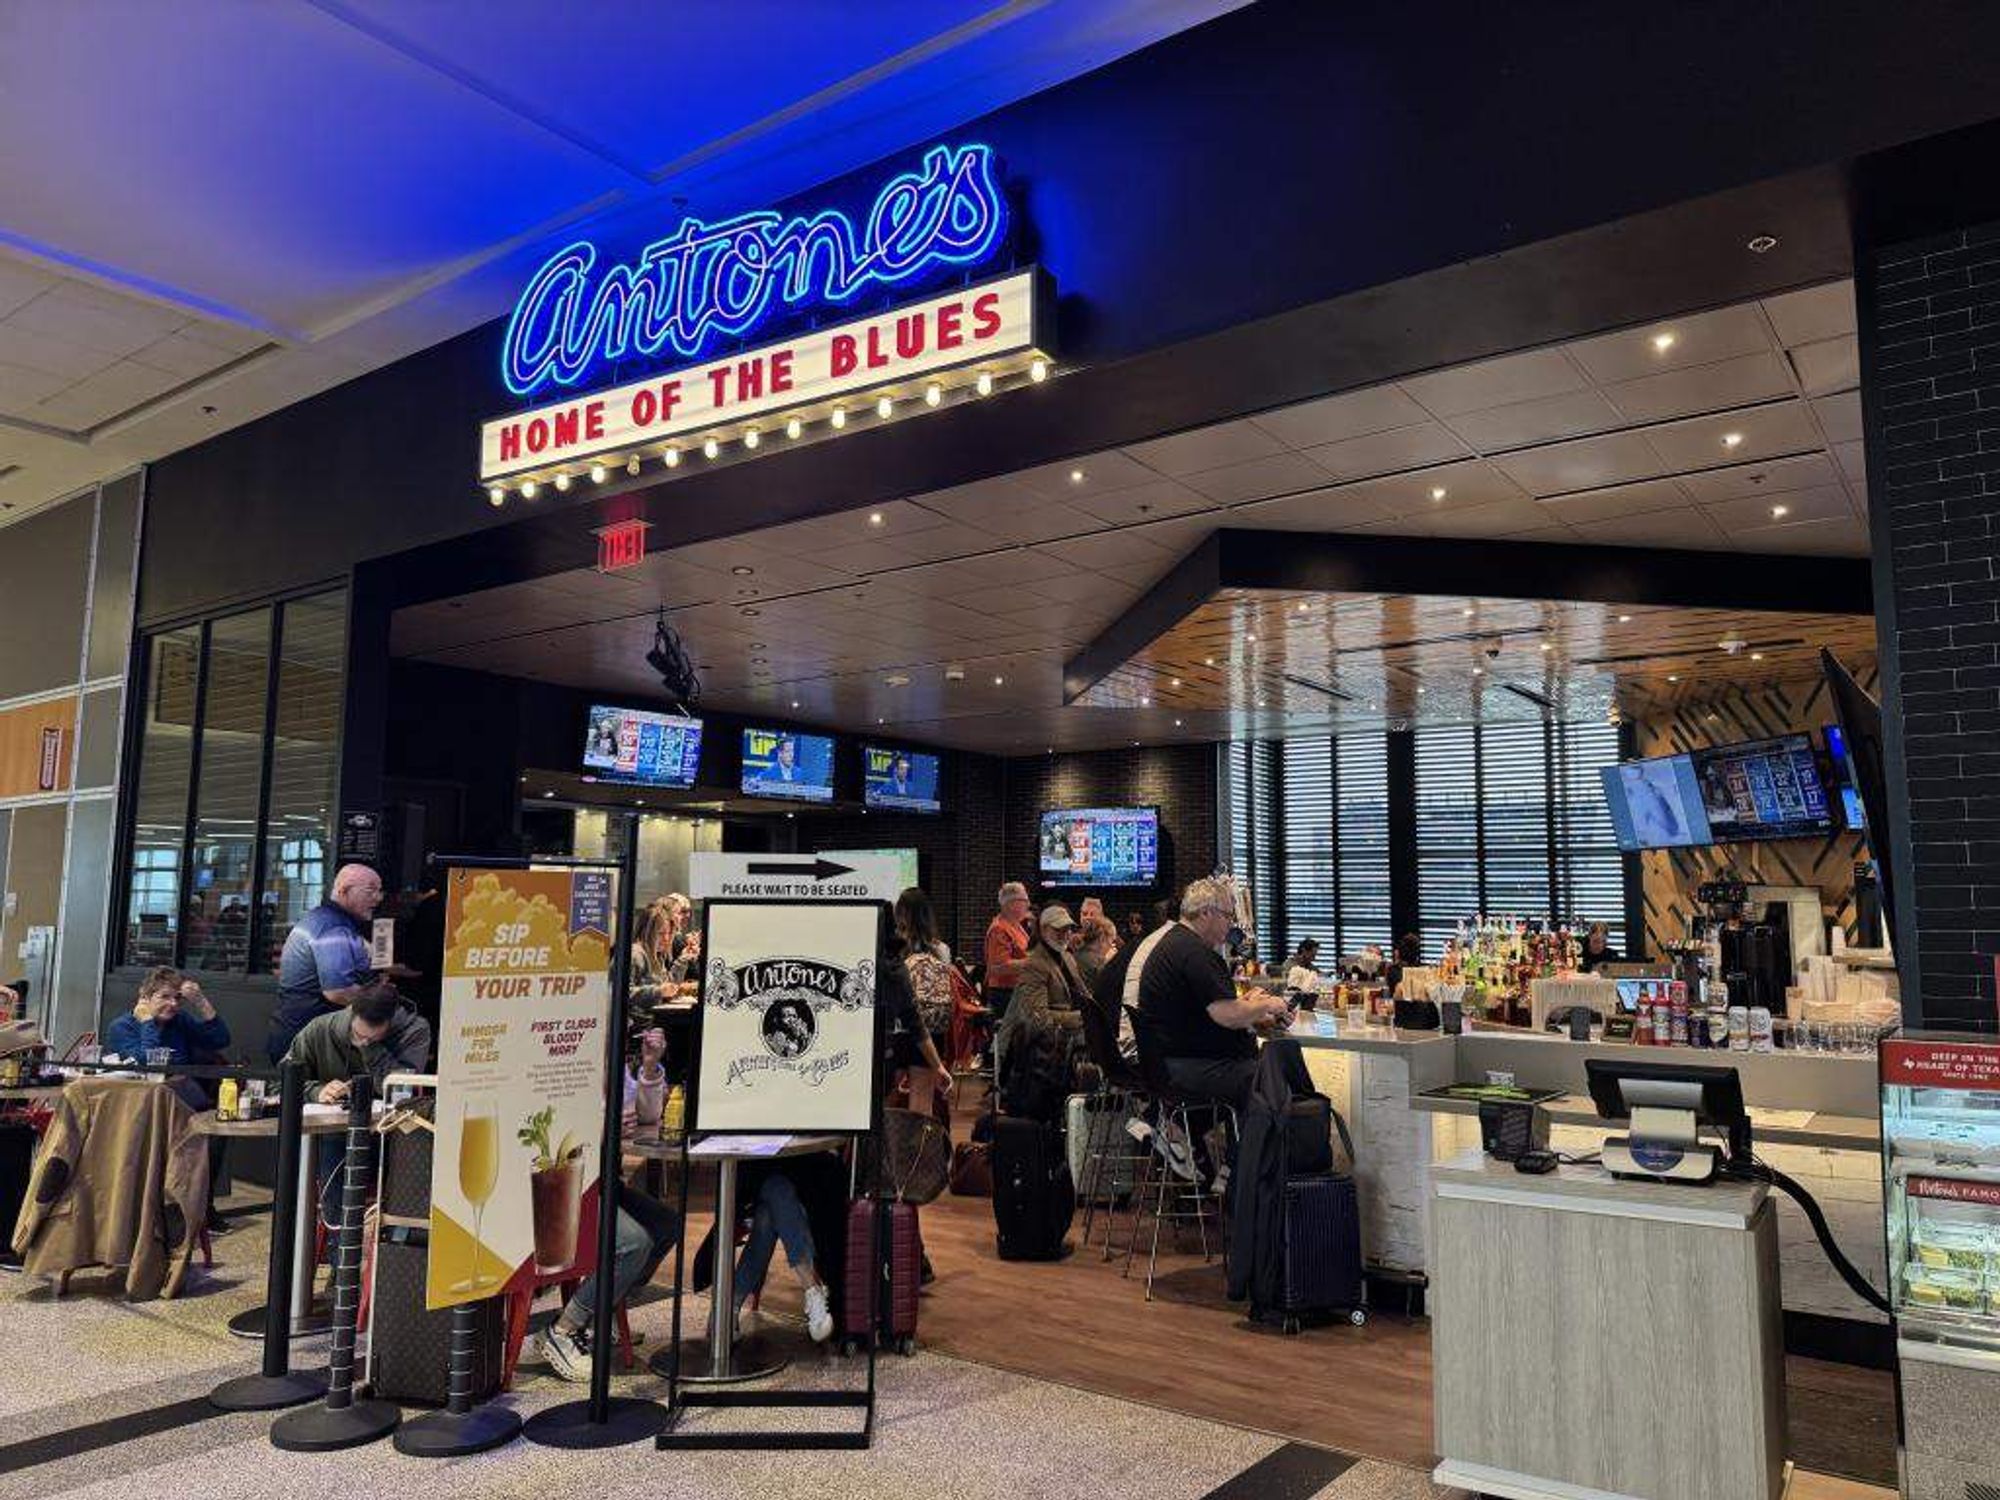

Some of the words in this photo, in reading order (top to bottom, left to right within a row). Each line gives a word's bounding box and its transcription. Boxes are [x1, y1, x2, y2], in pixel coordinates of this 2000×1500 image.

[500, 400, 605, 463] HOME
[631, 380, 682, 429] OF
[708, 349, 795, 409] THE
[830, 292, 1002, 379] BLUES
[722, 883, 761, 895] PLEASE
[764, 884, 792, 895] WAIT
[793, 884, 809, 896] TO
[810, 884, 825, 896] BE
[827, 884, 868, 896] SEATED
[494, 923, 530, 944] SIP
[465, 947, 550, 969] BEFORE
[475, 978, 532, 999] YOUR
[540, 976, 586, 996] TRIP
[531, 1020, 563, 1032] FIRST
[565, 1018, 597, 1030] CLASS
[543, 1031, 586, 1044] BLOODY
[465, 1051, 500, 1063] MILES
[548, 1045, 579, 1057] MARY
[1931, 1052, 1958, 1061] DEEP
[1961, 1054, 1974, 1062] IN
[1978, 1055, 1999, 1064] THE
[1954, 1064, 1969, 1072] OF
